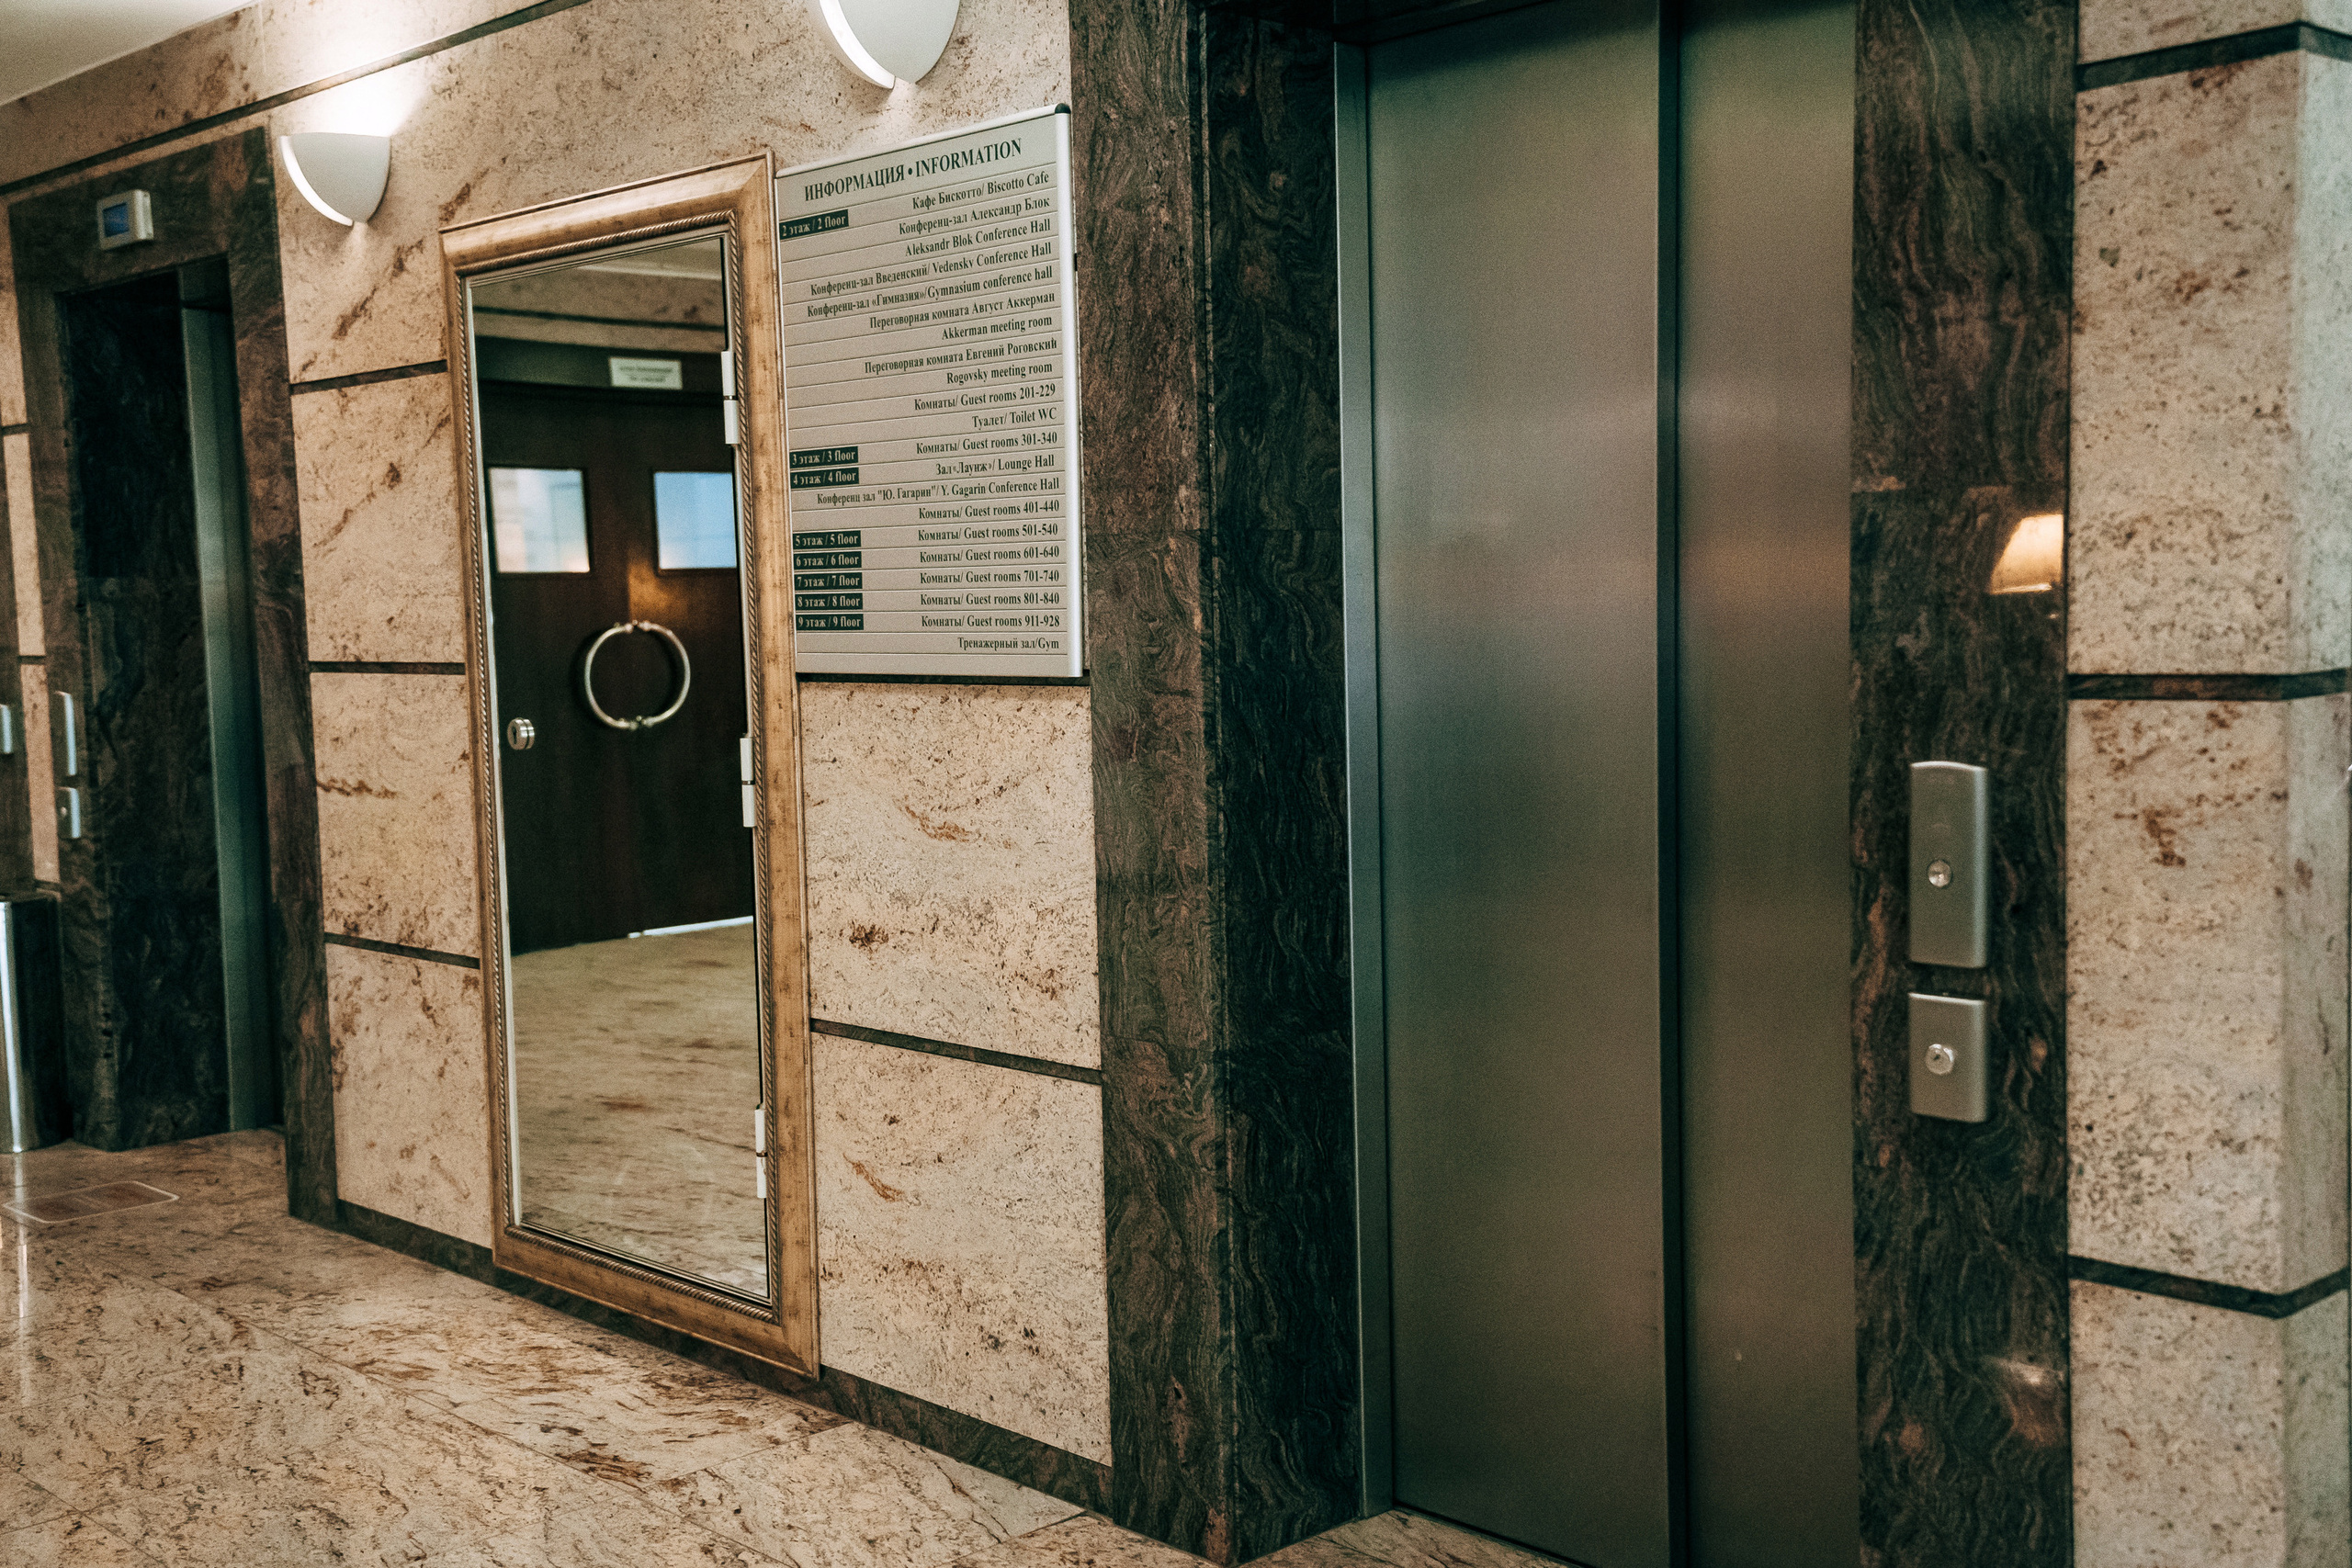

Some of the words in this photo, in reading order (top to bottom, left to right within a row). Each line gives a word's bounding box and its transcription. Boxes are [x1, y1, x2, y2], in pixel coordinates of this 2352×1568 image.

[804, 164, 905, 202] ИНФОРМАЦИЯ
[915, 139, 1021, 178] INFORMATION
[911, 195, 936, 211] Кафе
[987, 178, 1024, 195] Biscotto
[1026, 170, 1049, 186] Cafe
[971, 203, 1023, 221] Александр
[1023, 197, 1050, 211] Блок
[782, 224, 787, 237] 2
[789, 223, 810, 235] этаж
[817, 217, 822, 230] 2
[824, 215, 846, 229] floor
[905, 237, 951, 257] Aleksandr
[952, 232, 974, 249] Blok
[975, 225, 1028, 244] Conference
[1030, 218, 1051, 233] Hall
[976, 250, 1029, 267] Conference
[1031, 242, 1052, 258] Hall
[982, 272, 1032, 290] conference
[1034, 265, 1053, 281] hall
[869, 312, 930, 331] Переговорная
[932, 306, 970, 321] комната
[971, 301, 1003, 315] Август
[1006, 292, 1055, 310] Аккерман
[941, 325, 989, 341] Akkerman
[989, 318, 1026, 333] meeting
[1027, 316, 1053, 329] room
[865, 357, 924, 376] Переговорная
[926, 353, 964, 367] комната
[966, 344, 1005, 361] Евгений
[1007, 337, 1057, 355] Роговский
[946, 367, 988, 387] Rogovsky
[990, 364, 1027, 379] meeting
[1028, 363, 1053, 375] room
[960, 393, 987, 407] Guest
[989, 391, 1017, 403] rooms
[1019, 382, 1057, 400] 201-229
[1009, 410, 1035, 424] Toilet
[1037, 407, 1057, 421] WC
[962, 438, 989, 451] Guest
[990, 437, 1019, 449] rooms
[1021, 431, 1057, 446] 301-340
[792, 454, 797, 466] 3
[799, 455, 820, 465] этаж
[827, 450, 832, 463] 3
[834, 449, 855, 462] floor
[998, 458, 1033, 472] Lounge
[1035, 454, 1055, 468] Hall
[793, 474, 798, 485] 4
[799, 475, 821, 485] этаж
[828, 471, 833, 482] 4
[835, 470, 857, 482] floor
[817, 492, 861, 506] Конференц
[862, 492, 876, 502] зал
[941, 484, 950, 496] Y.
[951, 482, 987, 498] Gagarin
[988, 480, 1038, 494] Conference
[1040, 477, 1060, 491] Hall
[964, 505, 990, 518] Guest
[992, 505, 1022, 516] rooms
[1023, 499, 1060, 513] 401-440
[963, 526, 989, 539] Guest
[991, 527, 1020, 538] rooms
[1022, 523, 1058, 536] 501-540
[795, 536, 801, 547] 5
[802, 536, 823, 547] этаж
[830, 534, 835, 546] 5
[837, 534, 859, 545] floor
[796, 556, 802, 567] 6
[803, 558, 824, 567] этаж
[831, 555, 837, 566] 6
[838, 554, 860, 566] floor
[965, 548, 991, 561] Guest
[993, 550, 1022, 560] rooms
[1023, 545, 1060, 559] 601-640
[797, 577, 802, 587] 7
[804, 578, 825, 588] этаж
[831, 575, 837, 586] 7
[838, 575, 860, 586] floor
[965, 570, 991, 583] Guest
[993, 573, 1022, 582] rooms
[1023, 570, 1060, 582] 701-740
[797, 597, 803, 607] 8
[804, 598, 826, 607] этаж
[831, 596, 838, 607] 8
[839, 596, 861, 607] floor
[966, 592, 991, 605] Guest
[993, 595, 1022, 605] rooms
[1023, 592, 1060, 604] 801-840
[797, 617, 804, 626] 9
[805, 618, 826, 628] этаж
[832, 616, 839, 627] 9
[840, 616, 862, 627] floor
[967, 615, 992, 627] Guest
[994, 617, 1023, 627] rooms
[1024, 615, 1060, 627] 911-928
[956, 637, 1019, 652] Тренажерный
